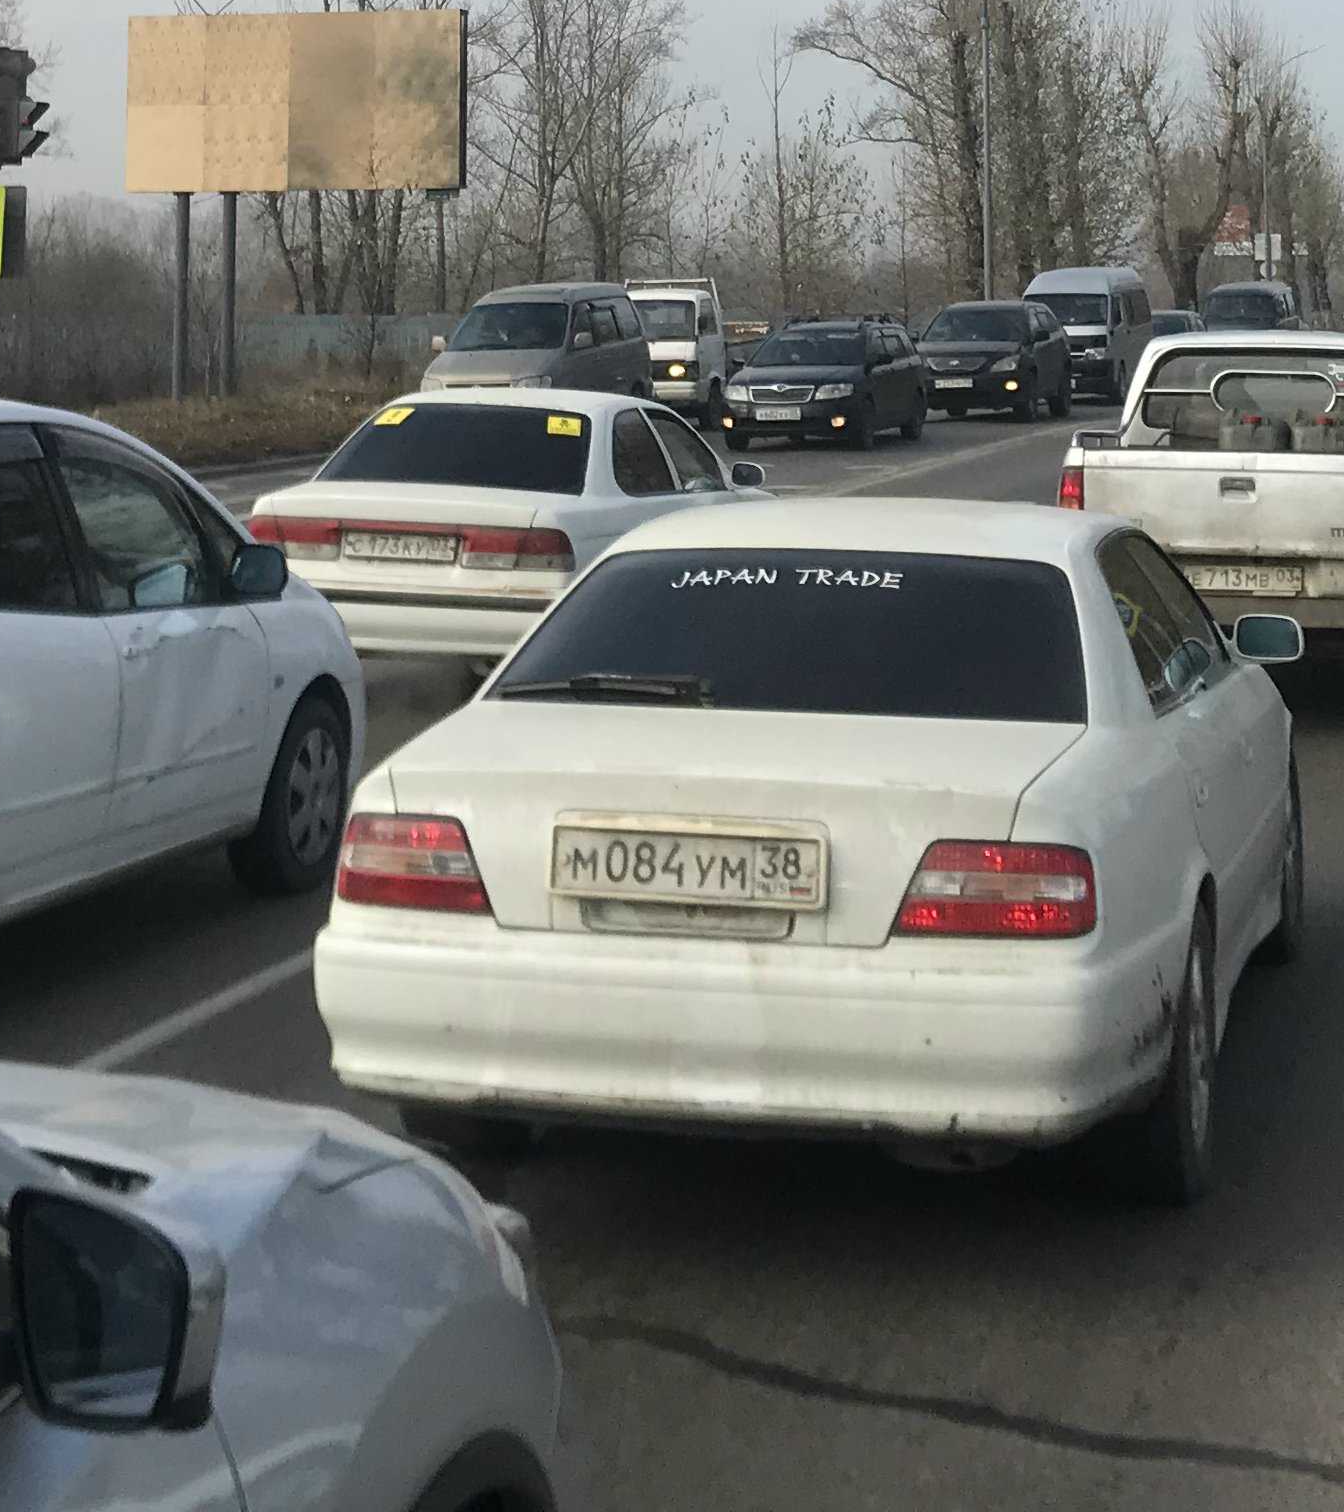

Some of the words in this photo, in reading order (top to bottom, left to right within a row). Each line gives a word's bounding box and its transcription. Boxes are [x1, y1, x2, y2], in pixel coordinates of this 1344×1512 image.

[672, 568, 778, 588] JAPAN
[796, 568, 904, 588] TRADE
[572, 839, 747, 890] М084УМ
[760, 845, 801, 880] 38
